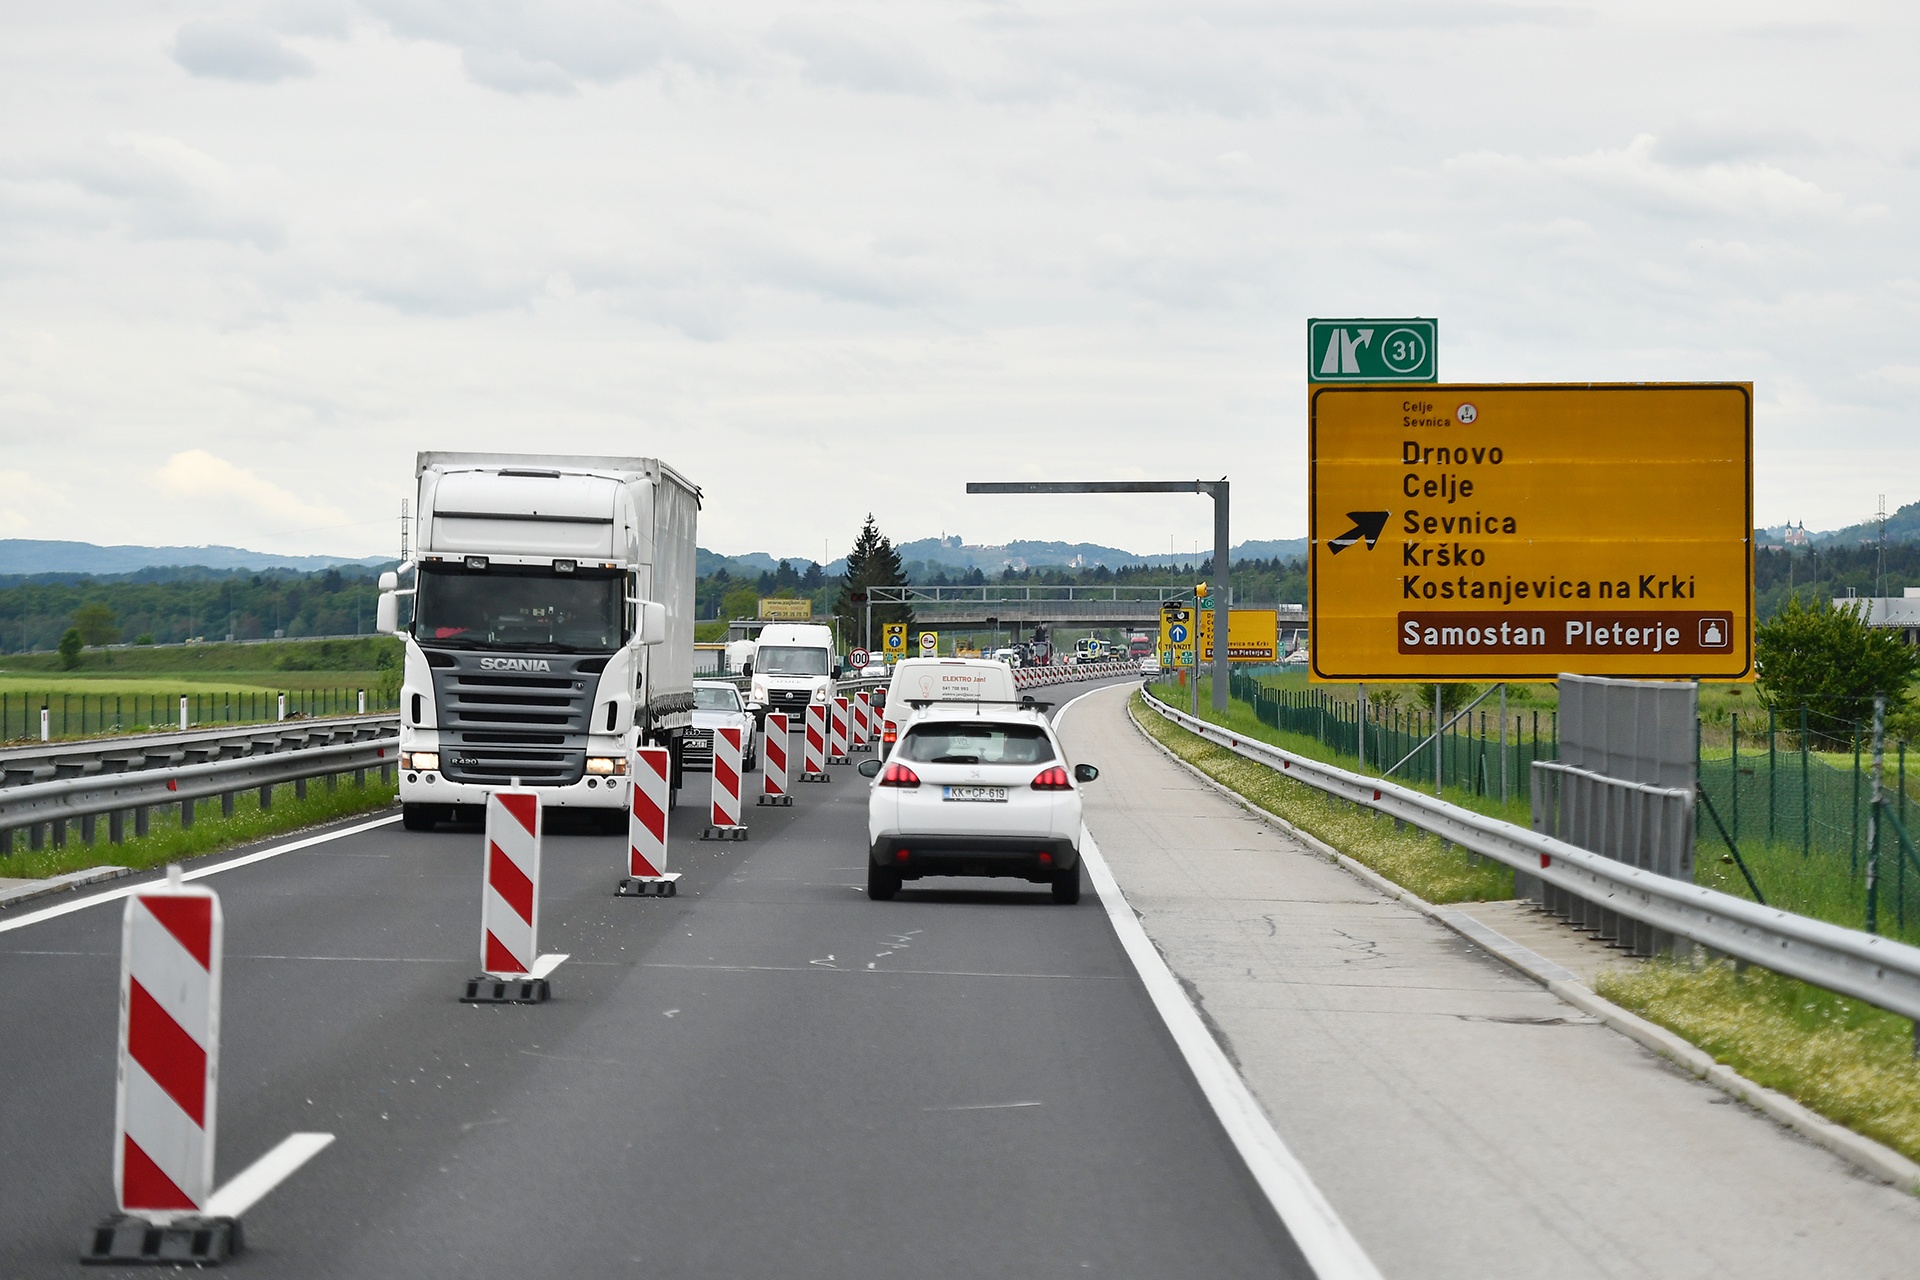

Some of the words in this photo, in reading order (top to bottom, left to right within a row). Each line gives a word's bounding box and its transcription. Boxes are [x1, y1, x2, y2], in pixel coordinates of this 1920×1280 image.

[1392, 341, 1415, 361] 31
[1403, 401, 1433, 414] Celje
[1403, 416, 1451, 427] Sevnica
[1402, 441, 1504, 466] Drnovo
[1403, 473, 1474, 504] Celje
[1403, 510, 1517, 535] Sevnica
[1403, 543, 1486, 567] Krško
[1403, 575, 1591, 605] Kostanjevica
[1599, 581, 1631, 600] na
[1638, 575, 1696, 599] Krki
[1403, 621, 1546, 647] Samostan
[1566, 621, 1680, 652] Pleterje
[480, 657, 551, 673] SCANIA
[852, 653, 867, 664] 100
[942, 675, 972, 683] ELEKTRO
[951, 788, 965, 798] KK
[972, 788, 1005, 798] CP-619
